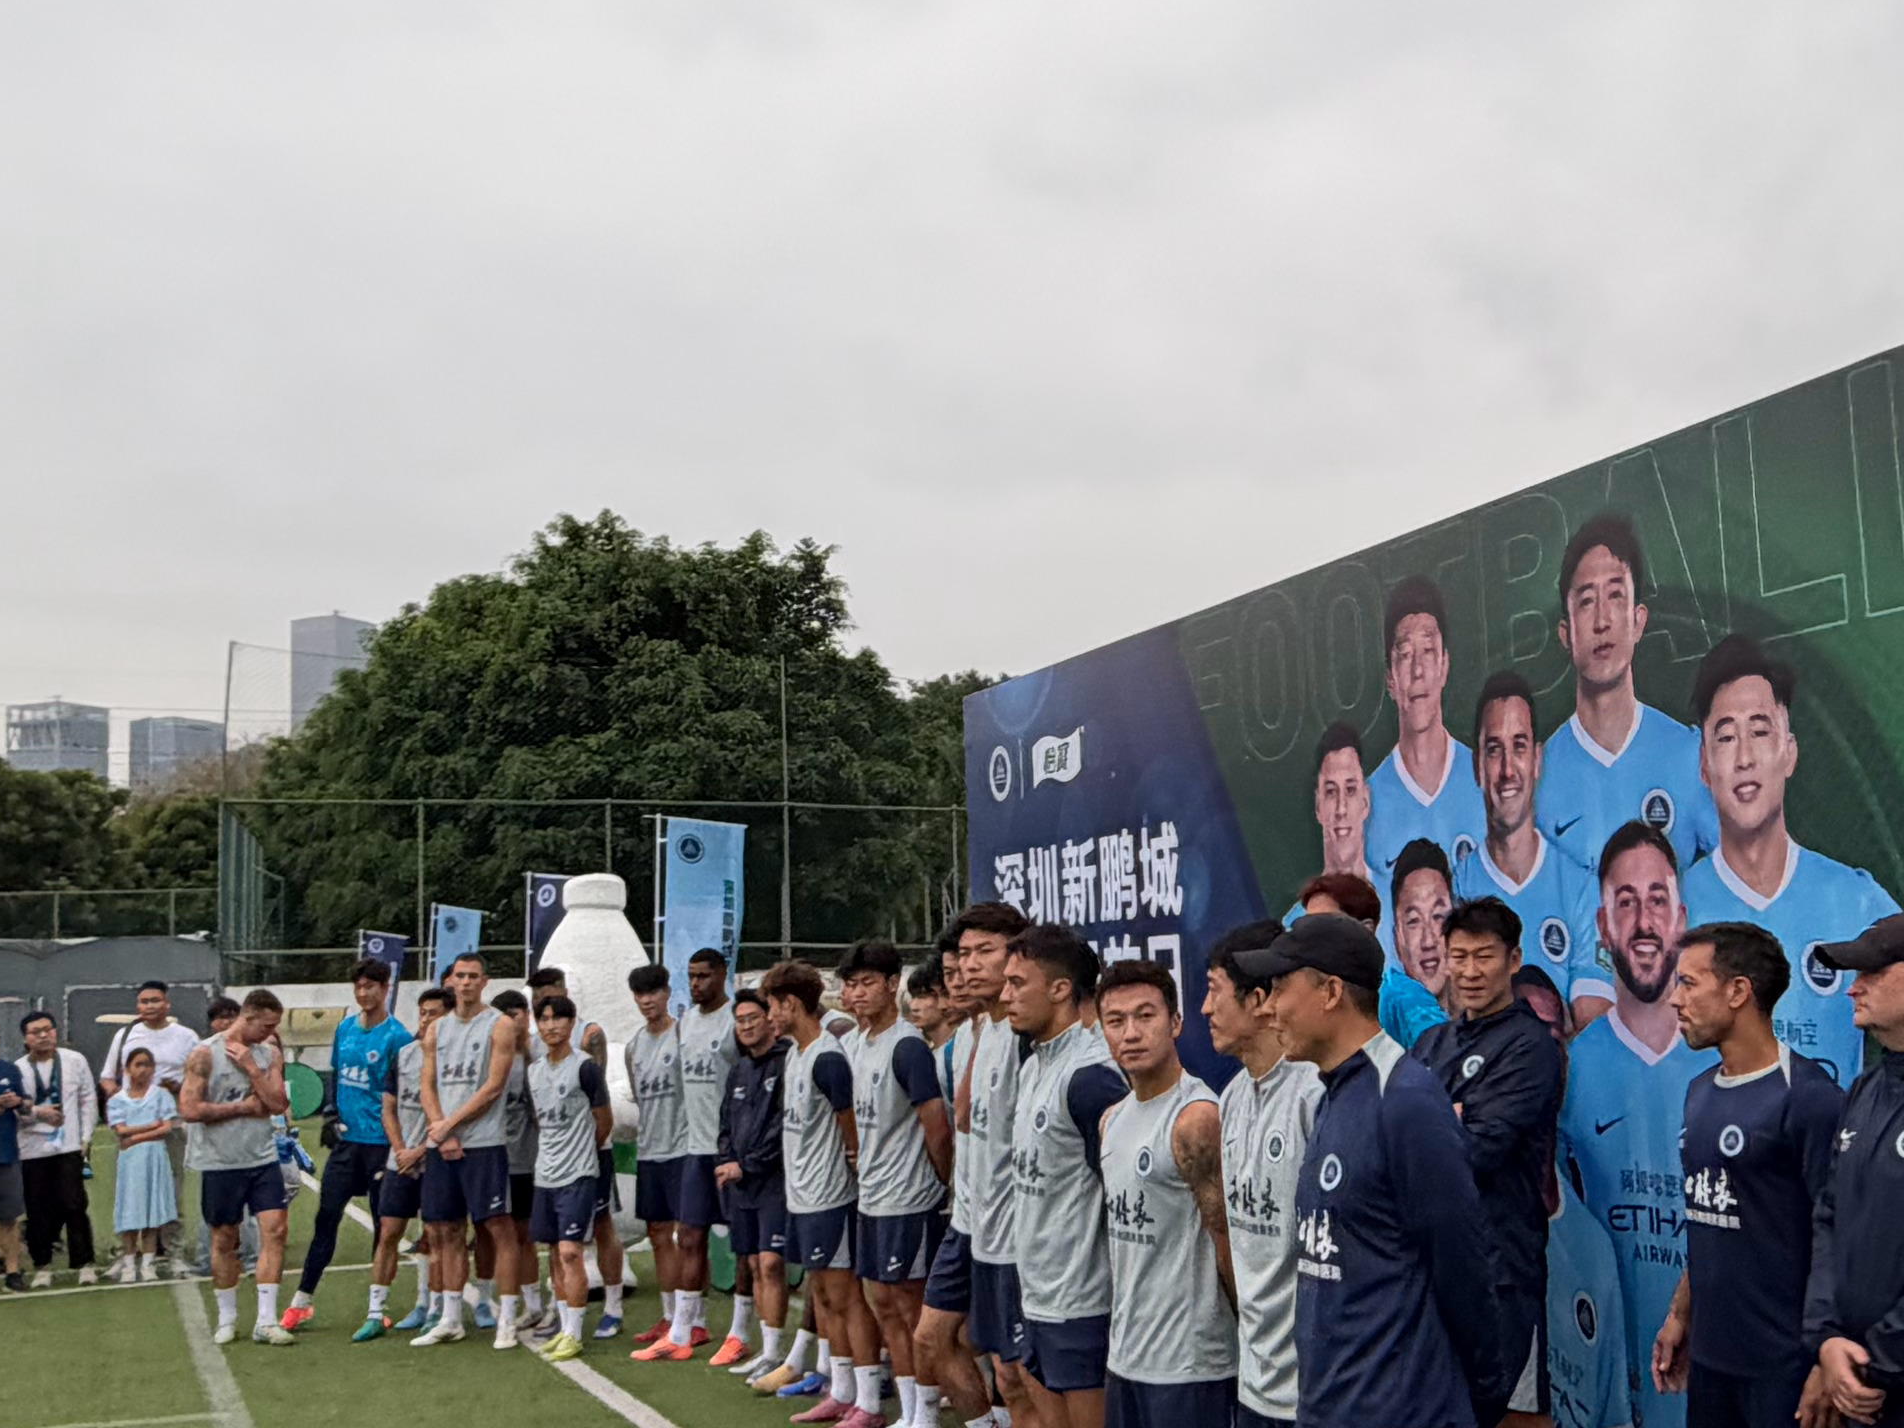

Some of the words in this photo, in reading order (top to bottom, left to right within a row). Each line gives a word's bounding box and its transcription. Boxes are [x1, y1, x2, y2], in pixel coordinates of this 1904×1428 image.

[994, 821, 1183, 926] 深圳新鹏城
[1633, 1241, 1689, 1269] AIRWA
